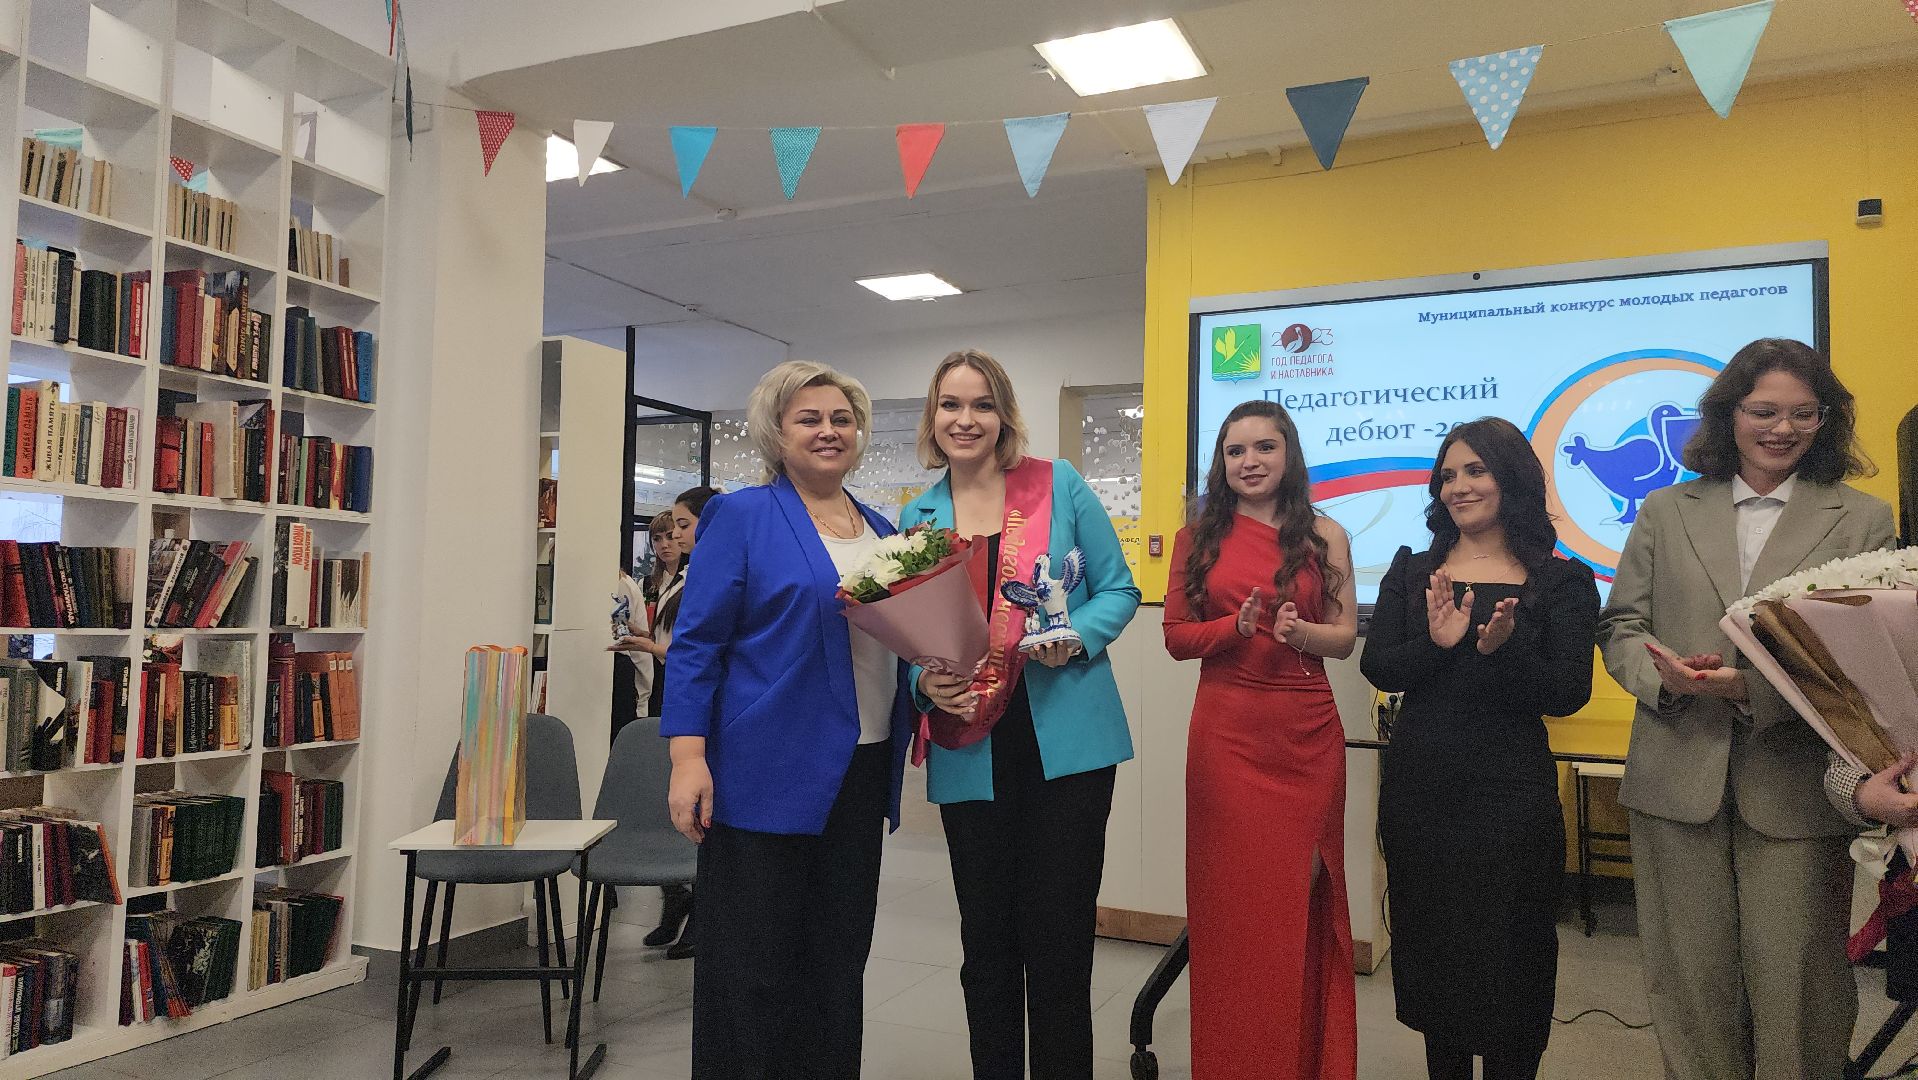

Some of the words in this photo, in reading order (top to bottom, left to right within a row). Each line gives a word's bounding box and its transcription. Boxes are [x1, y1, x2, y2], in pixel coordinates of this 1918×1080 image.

[1418, 302, 1545, 323] Муниципальный
[1550, 297, 1614, 313] конкурс
[1619, 291, 1694, 307] молодых
[1700, 284, 1788, 301] педагогов
[1270, 371, 1276, 379] И
[1278, 367, 1334, 379] НАСТАВНИКА
[1271, 356, 1287, 366] ГОД
[1289, 353, 1334, 365] ПЕДАГОГА
[1262, 377, 1498, 412] Педагогический
[23, 396, 33, 429] ПАМЯТЬ
[47, 400, 55, 437] ПАМЯТЬ
[22, 431, 31, 459] ЖИВАЯ
[1325, 418, 1415, 446] дебют
[45, 439, 53, 471] ЖИВАЯ
[988, 509, 1028, 671] «Педагоческий
